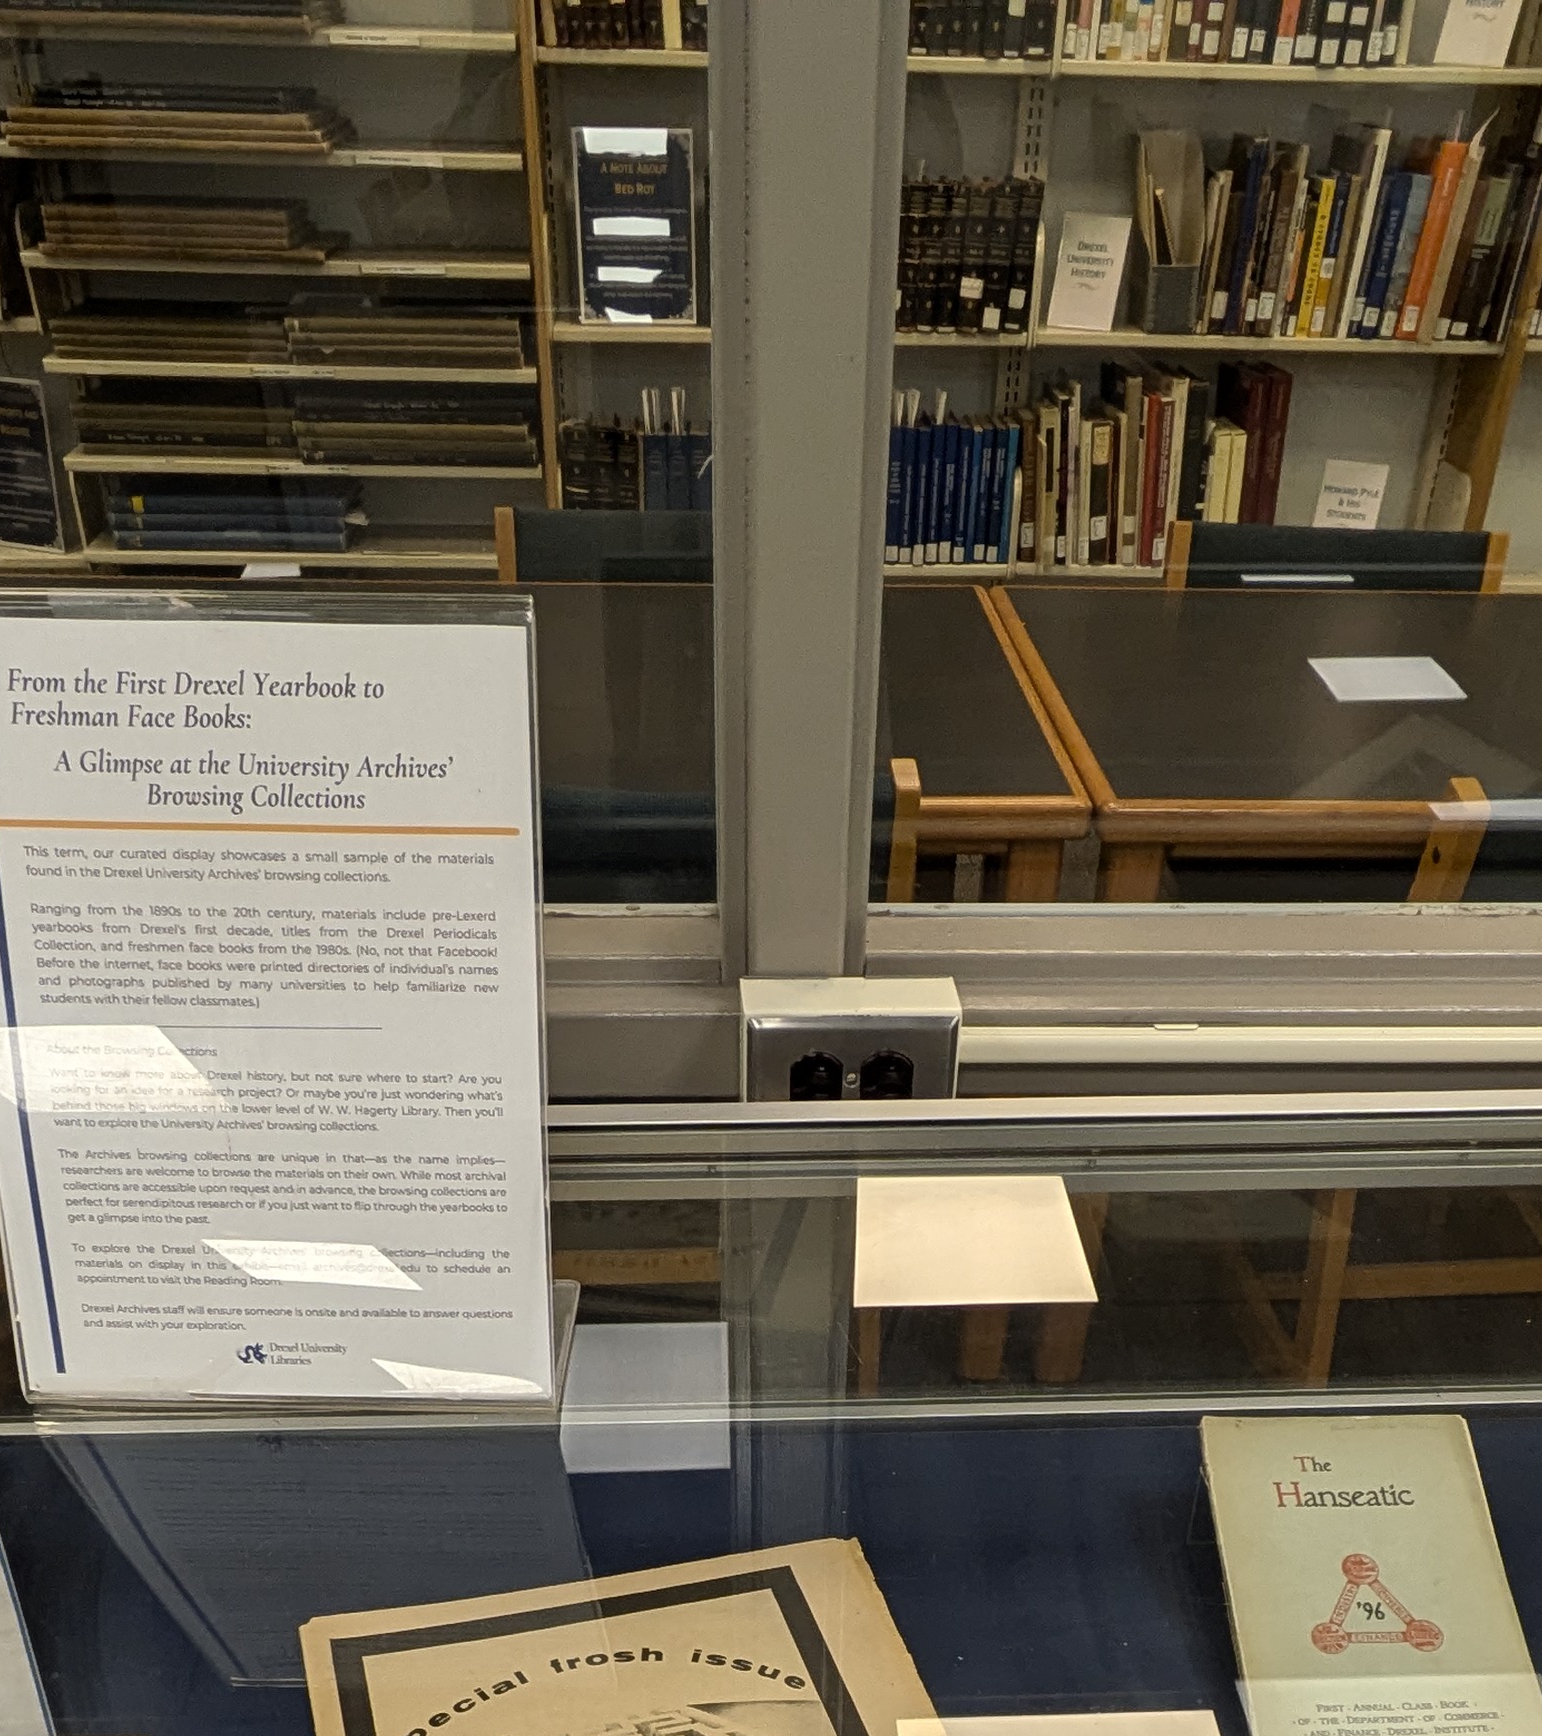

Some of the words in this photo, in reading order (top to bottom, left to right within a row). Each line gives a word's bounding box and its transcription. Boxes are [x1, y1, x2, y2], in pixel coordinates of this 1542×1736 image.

[6, 669, 65, 693] From
[72, 670, 107, 694] the
[115, 671, 164, 695] First
[173, 672, 244, 696] Drexel
[255, 673, 356, 698] Yearbook
[361, 675, 384, 699] to
[9, 702, 118, 726] Freshman
[126, 703, 174, 727] Face
[182, 704, 251, 729] Books:
[53, 750, 69, 774] A
[78, 750, 163, 781] Glimpse
[167, 751, 191, 776] at
[196, 752, 230, 776] the
[237, 753, 349, 784] University
[357, 755, 453, 780] Archives'
[146, 784, 243, 813] Browsing
[248, 785, 365, 809] Collections
[24, 844, 49, 856] This
[53, 846, 89, 861] term,
[92, 849, 114, 859] our
[119, 847, 167, 859] curated
[171, 847, 215, 863] display
[219, 848, 286, 861] showcases
[291, 852, 299, 862] a
[304, 849, 338, 862] small
[342, 850, 389, 866] sample
[392, 850, 406, 863] of
[410, 851, 432, 864] the
[436, 852, 494, 864] materials
[25, 864, 62, 876] found
[65, 865, 77, 877] in
[78, 865, 101, 877] the
[102, 865, 142, 878] Drexel
[145, 866, 205, 882] University
[206, 867, 261, 880] Archives'
[263, 868, 320, 884] browsing
[324, 869, 392, 882] collections.
[29, 902, 81, 917] Ranging
[86, 903, 116, 915] from
[121, 903, 143, 916] the
[148, 904, 182, 916] 1890s
[187, 905, 201, 917] to
[205, 905, 227, 917] the
[232, 905, 260, 917] 20th
[266, 907, 316, 922] century,
[320, 907, 376, 920] materials
[381, 908, 426, 921] include
[431, 909, 496, 925] pre-Lexerd
[31, 920, 94, 936] yearbooks
[101, 921, 131, 934] from
[139, 922, 186, 935] Drexel's
[193, 923, 217, 935] first
[225, 924, 274, 939] decade,
[280, 924, 311, 937] titles
[318, 925, 348, 937] from
[356, 925, 377, 938] the
[385, 926, 424, 938] Drexel
[432, 927, 497, 939] Periodicals
[33, 938, 97, 954] Collection,
[99, 939, 124, 952] and
[127, 940, 185, 952] freshmen
[188, 941, 214, 953] face
[217, 941, 254, 954] books
[257, 942, 287, 954] from
[290, 942, 312, 955] the
[315, 942, 352, 955] 1980s.
[355, 943, 381, 959] (No,
[382, 944, 404, 956] not
[407, 944, 432, 956] that
[436, 945, 498, 957] Facebook!
[80, 1302, 115, 1313] Drexel
[115, 1303, 160, 1314] Archives
[161, 1303, 185, 1314] staff
[186, 1304, 205, 1315] will
[206, 1307, 243, 1316] ensure
[243, 1307, 293, 1316] someone
[293, 1307, 303, 1317] is
[304, 1307, 337, 1317] onsite
[338, 1307, 360, 1318] and
[360, 1307, 407, 1318] available
[408, 1308, 421, 1318] to
[421, 1310, 460, 1318] answer
[461, 1309, 513, 1321] questions
[82, 1317, 104, 1328] and
[104, 1318, 133, 1328] assist
[134, 1318, 159, 1329] with
[160, 1321, 184, 1332] your
[185, 1319, 248, 1333] exploration.
[300, 1342, 347, 1355] University
[271, 1356, 312, 1365] Libraries
[1293, 1456, 1332, 1473] The
[1273, 1481, 1415, 1508] Hanseatic
[1356, 1601, 1386, 1621] '96
[549, 1646, 664, 1675] frosh
[691, 1648, 807, 1691] issue
[1353, 1703, 1395, 1712] ANNUAL
[1402, 1702, 1433, 1711] CLASS
[1440, 1700, 1469, 1710] BOOK
[1346, 1715, 1415, 1725] DEPARTMENT
